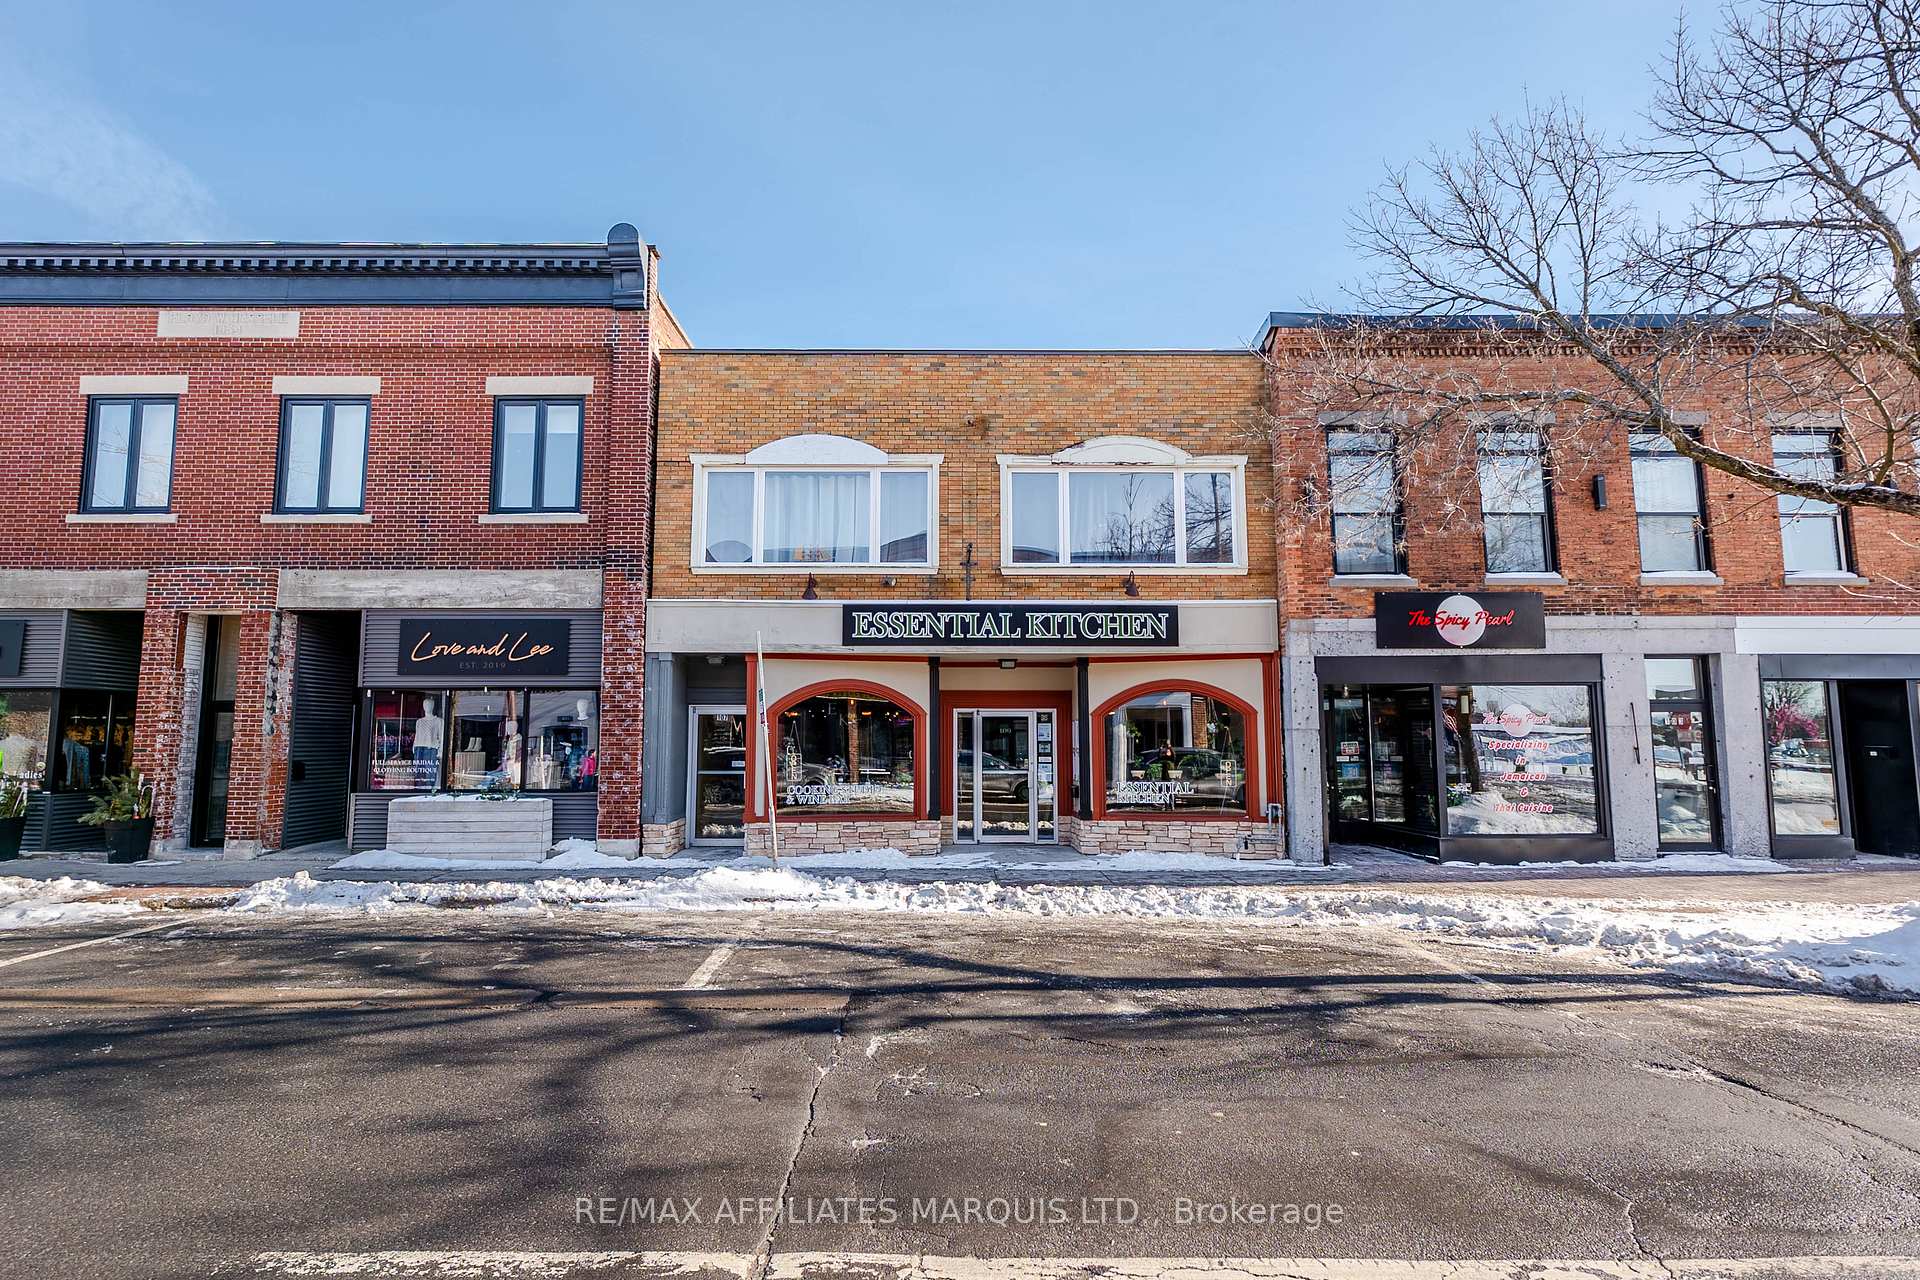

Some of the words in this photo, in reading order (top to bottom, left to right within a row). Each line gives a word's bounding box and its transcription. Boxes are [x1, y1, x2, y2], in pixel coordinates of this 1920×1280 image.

[1408, 610, 1431, 626] The
[1434, 610, 1471, 630] Spicy
[1475, 609, 1515, 625] Pearl
[852, 612, 1021, 639] ESSENTIAL
[1025, 612, 1168, 639] KITCHEN
[411, 632, 465, 661] Love
[466, 633, 509, 656] and
[508, 632, 554, 661] Lee
[482, 661, 507, 669] 2019
[1488, 739, 1549, 752] Specializing
[1515, 755, 1526, 765] in
[1500, 772, 1547, 783] Jamaican
[1116, 782, 1195, 794] ESSENTIAL
[1519, 786, 1529, 797] &
[1116, 793, 1170, 804] KITCHEN
[1494, 802, 1516, 813] Thai
[1516, 802, 1553, 813] Cuisine
